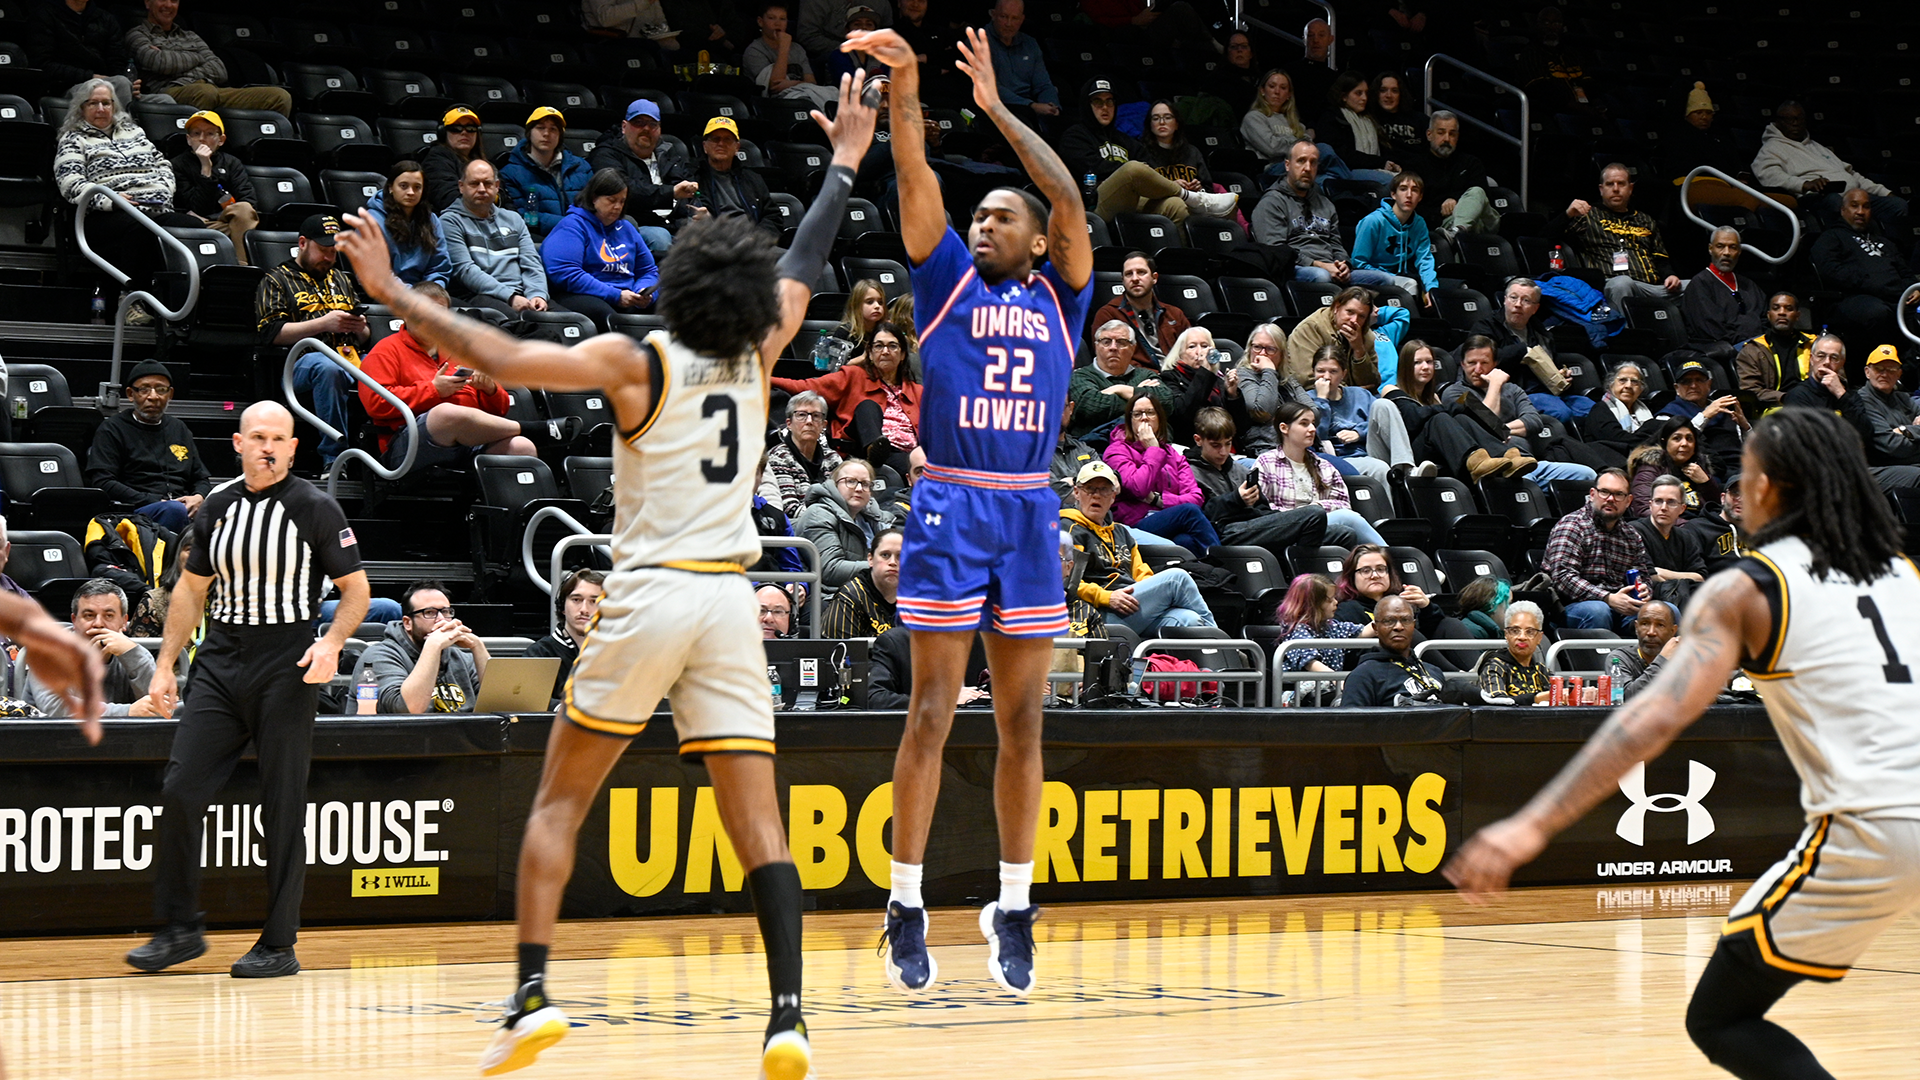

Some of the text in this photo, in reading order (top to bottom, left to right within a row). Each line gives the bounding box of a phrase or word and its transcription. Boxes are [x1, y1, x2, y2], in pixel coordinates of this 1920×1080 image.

[972, 305, 1050, 343] UMASS
[984, 346, 1036, 394] 22
[958, 395, 1046, 433] LOWELL
[701, 394, 738, 483] 3
[1857, 595, 1912, 684] 1
[1032, 771, 1448, 884] RETRIEVERS
[384, 876, 431, 888] I WILL.
[1596, 861, 1654, 876] UNDER
